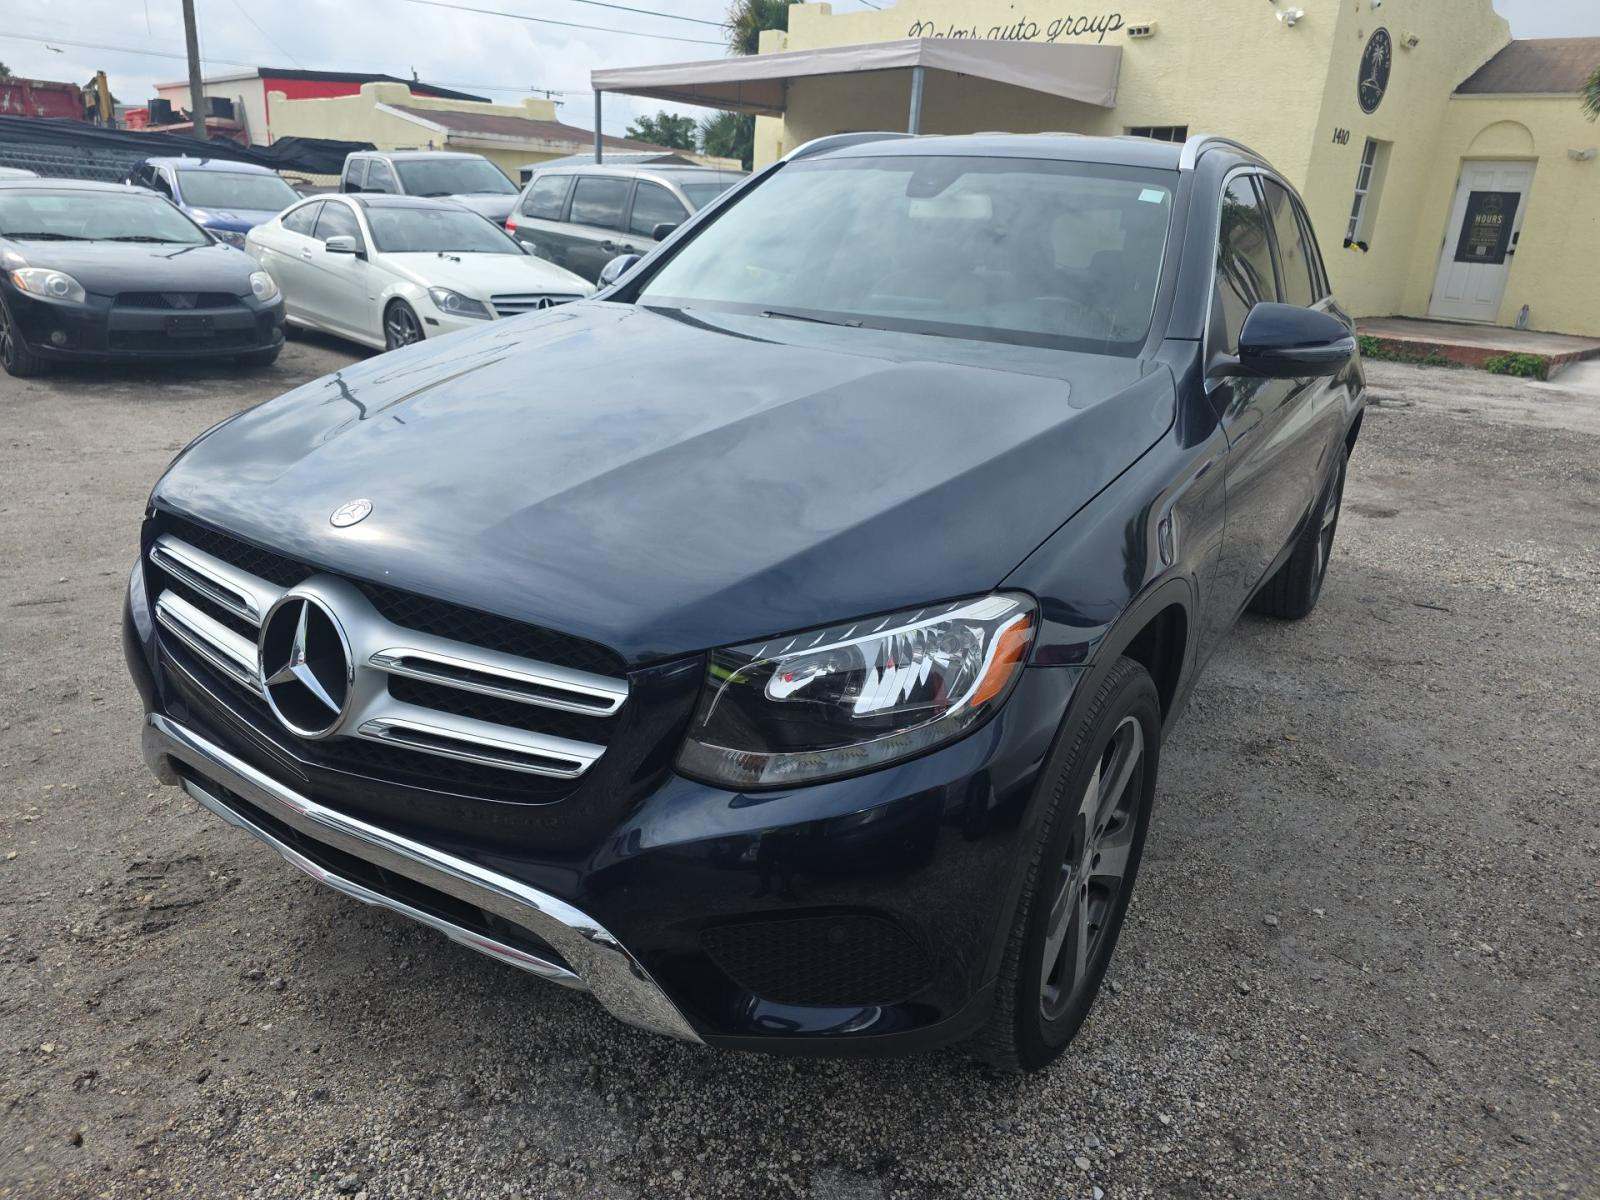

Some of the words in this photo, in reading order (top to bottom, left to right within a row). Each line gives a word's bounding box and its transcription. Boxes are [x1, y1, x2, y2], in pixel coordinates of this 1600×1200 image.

[987, 16, 1040, 40] auto
[1046, 13, 1125, 43] group
[1332, 127, 1350, 146] 1410
[1475, 214, 1503, 224] HOURS
